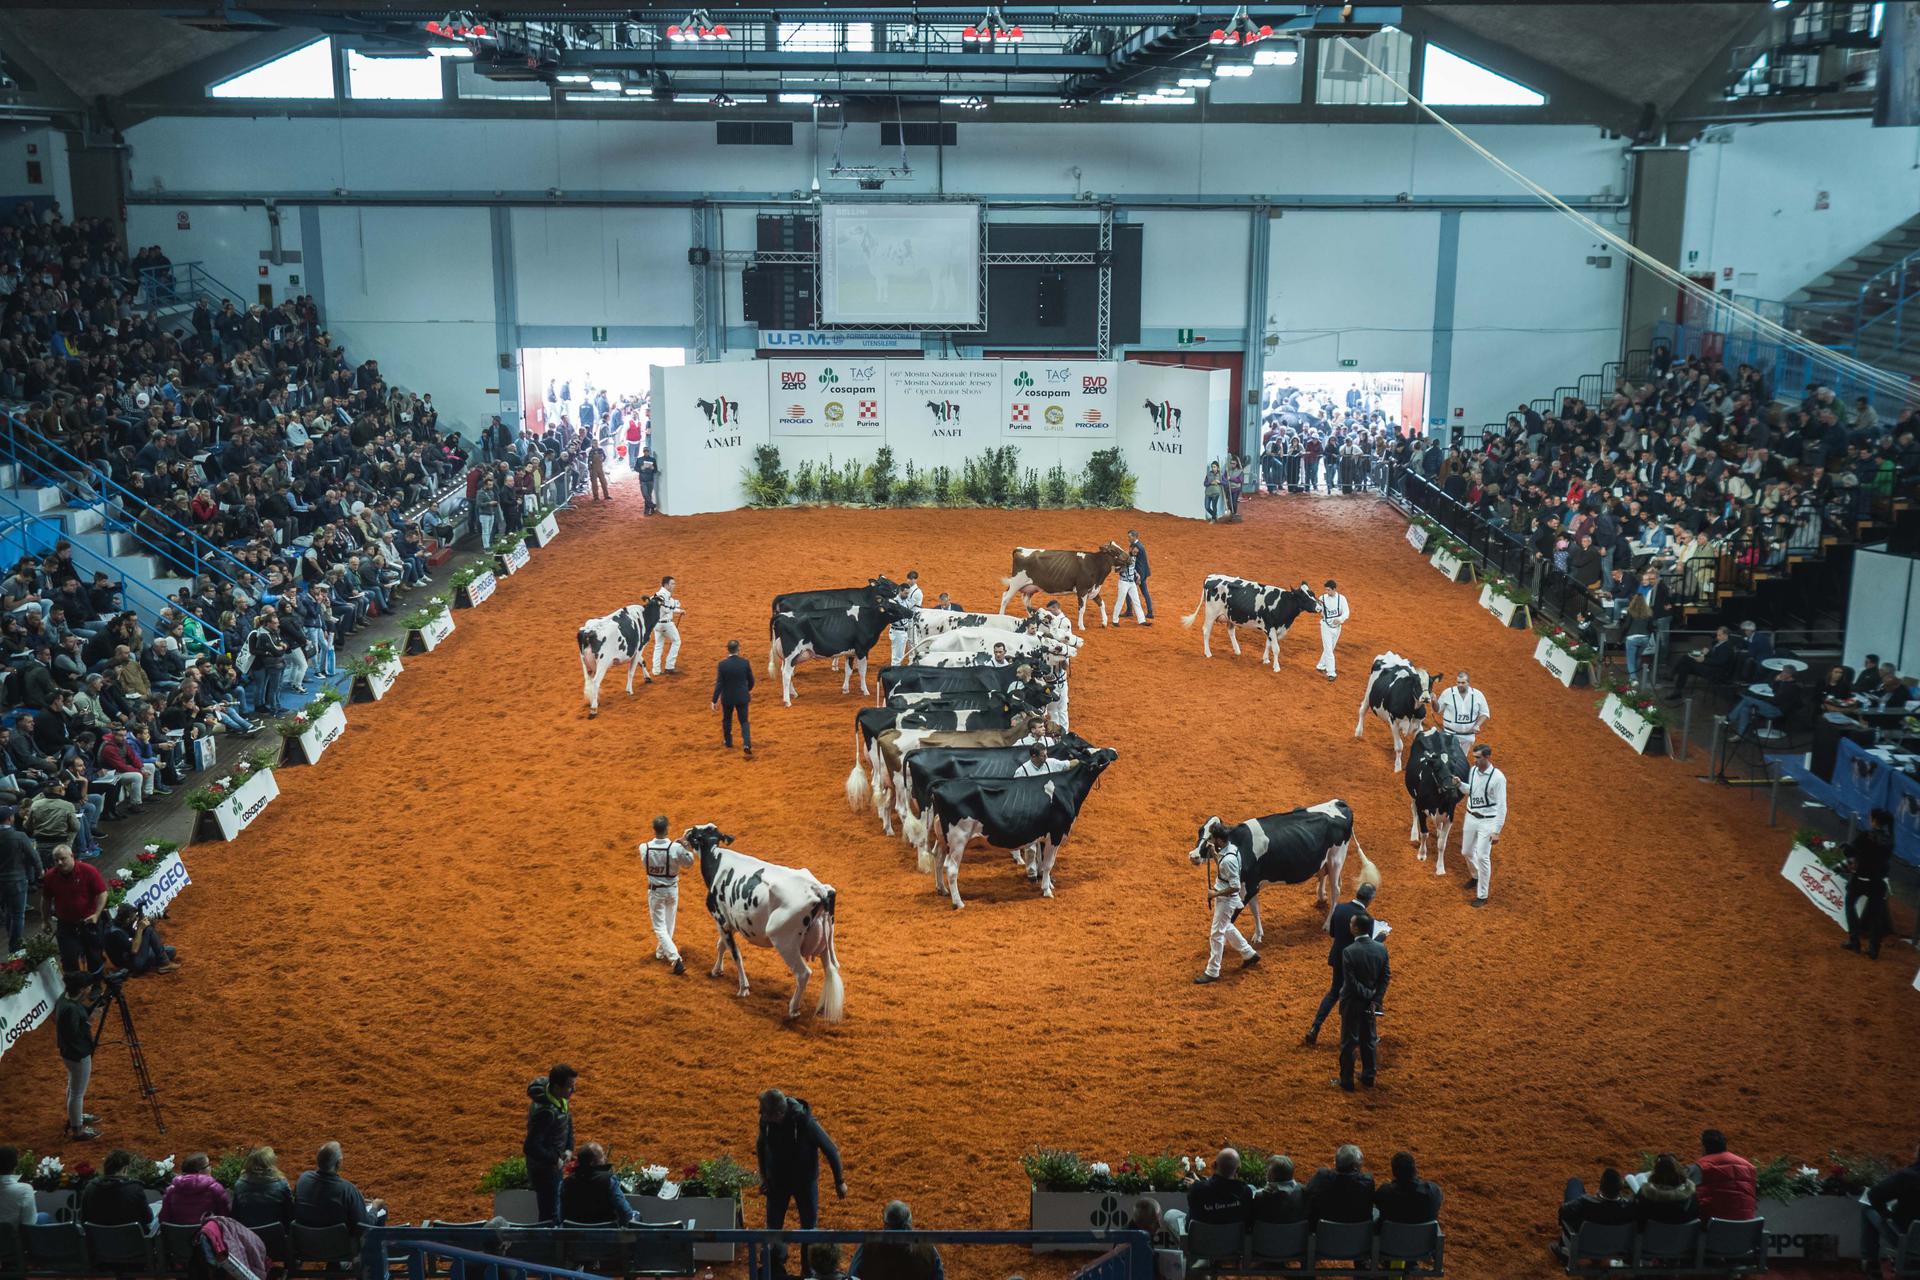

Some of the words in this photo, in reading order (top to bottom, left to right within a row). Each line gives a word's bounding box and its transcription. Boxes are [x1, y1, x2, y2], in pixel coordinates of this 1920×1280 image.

[781, 372, 806, 382] BVD
[1082, 376, 1107, 386] BVD
[781, 381, 807, 390] zero
[969, 379, 992, 387] Jersey
[830, 386, 876, 395] cosapam
[1025, 389, 1071, 399] cosapam
[1082, 386, 1107, 395] zero
[1009, 423, 1032, 431] Purina
[932, 429, 961, 437] ANAFI
[704, 436, 742, 450] ANAFI
[1149, 440, 1183, 455] ANAFI
[241, 795, 268, 823] cosapam
[1800, 866, 1825, 895] Raggio
[5, 999, 49, 1044] cosapam
